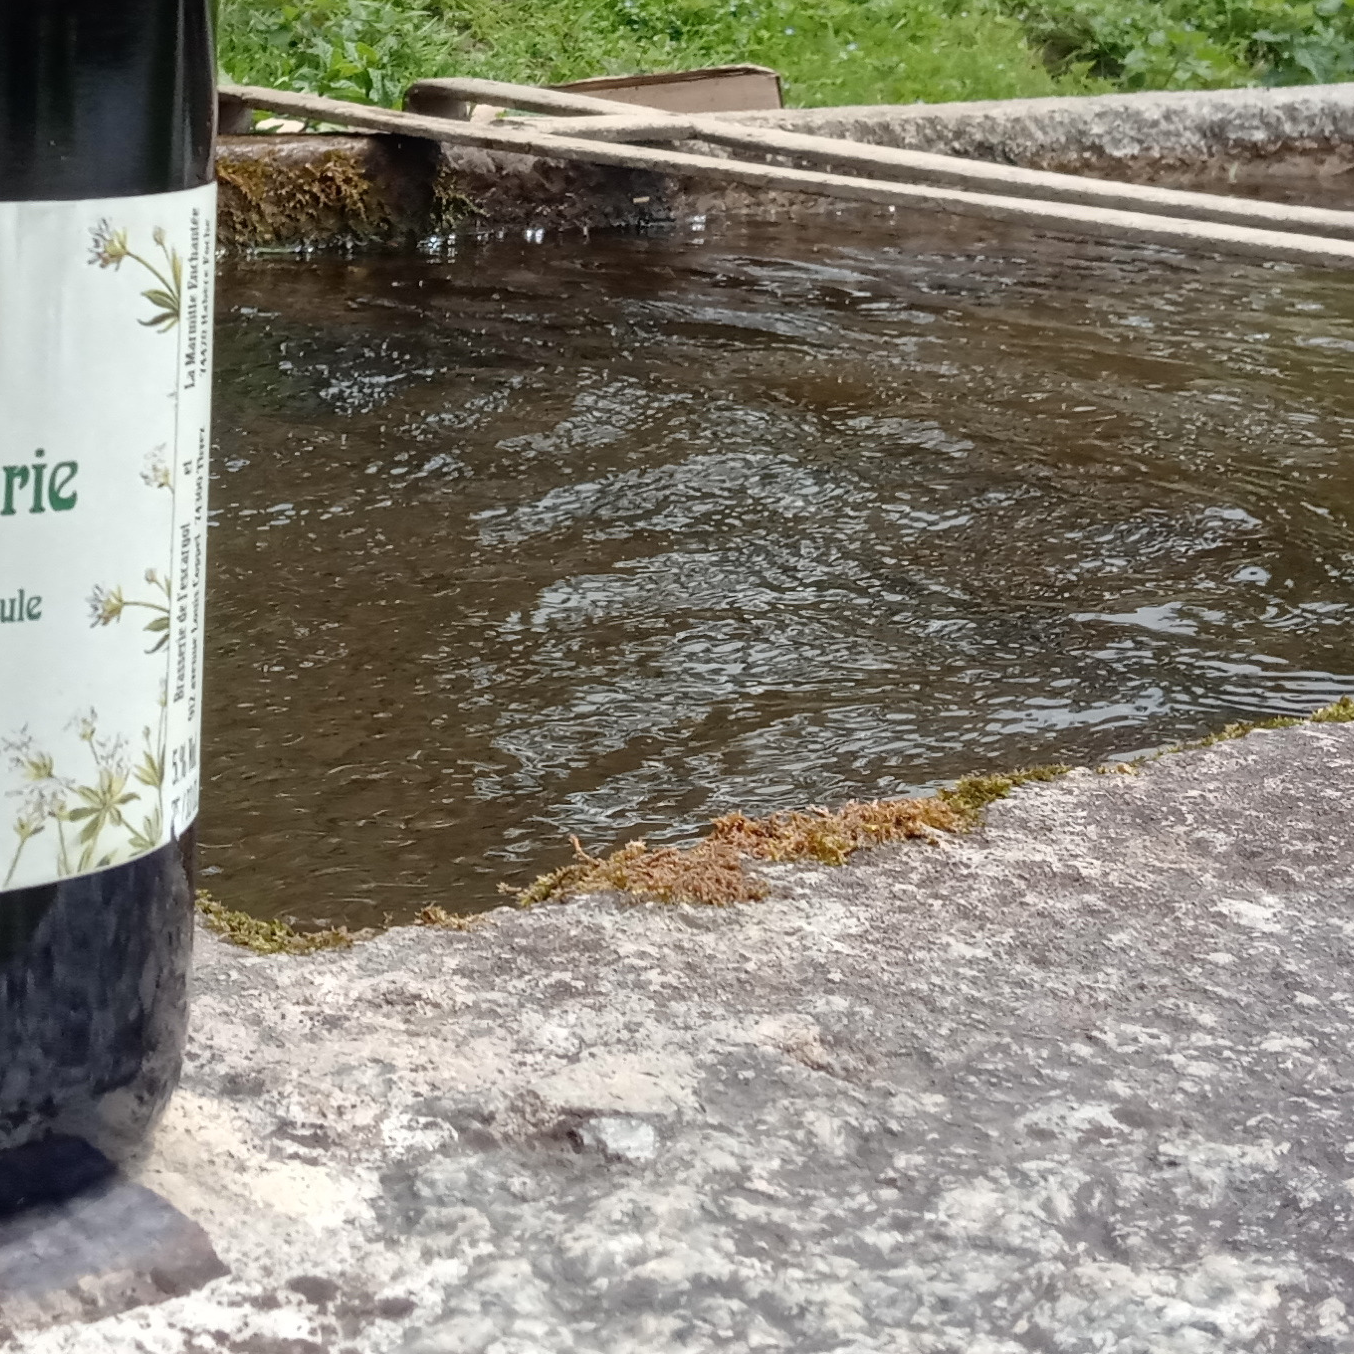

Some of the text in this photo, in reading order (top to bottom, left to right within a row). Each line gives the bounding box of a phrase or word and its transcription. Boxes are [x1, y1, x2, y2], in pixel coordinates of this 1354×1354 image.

[187, 207, 200, 289] Enchantée
[184, 295, 198, 366] Marmite
[184, 370, 196, 390] La
[177, 523, 191, 602] l'escargot
[176, 605, 187, 623] de
[173, 627, 187, 702] Brasserie
